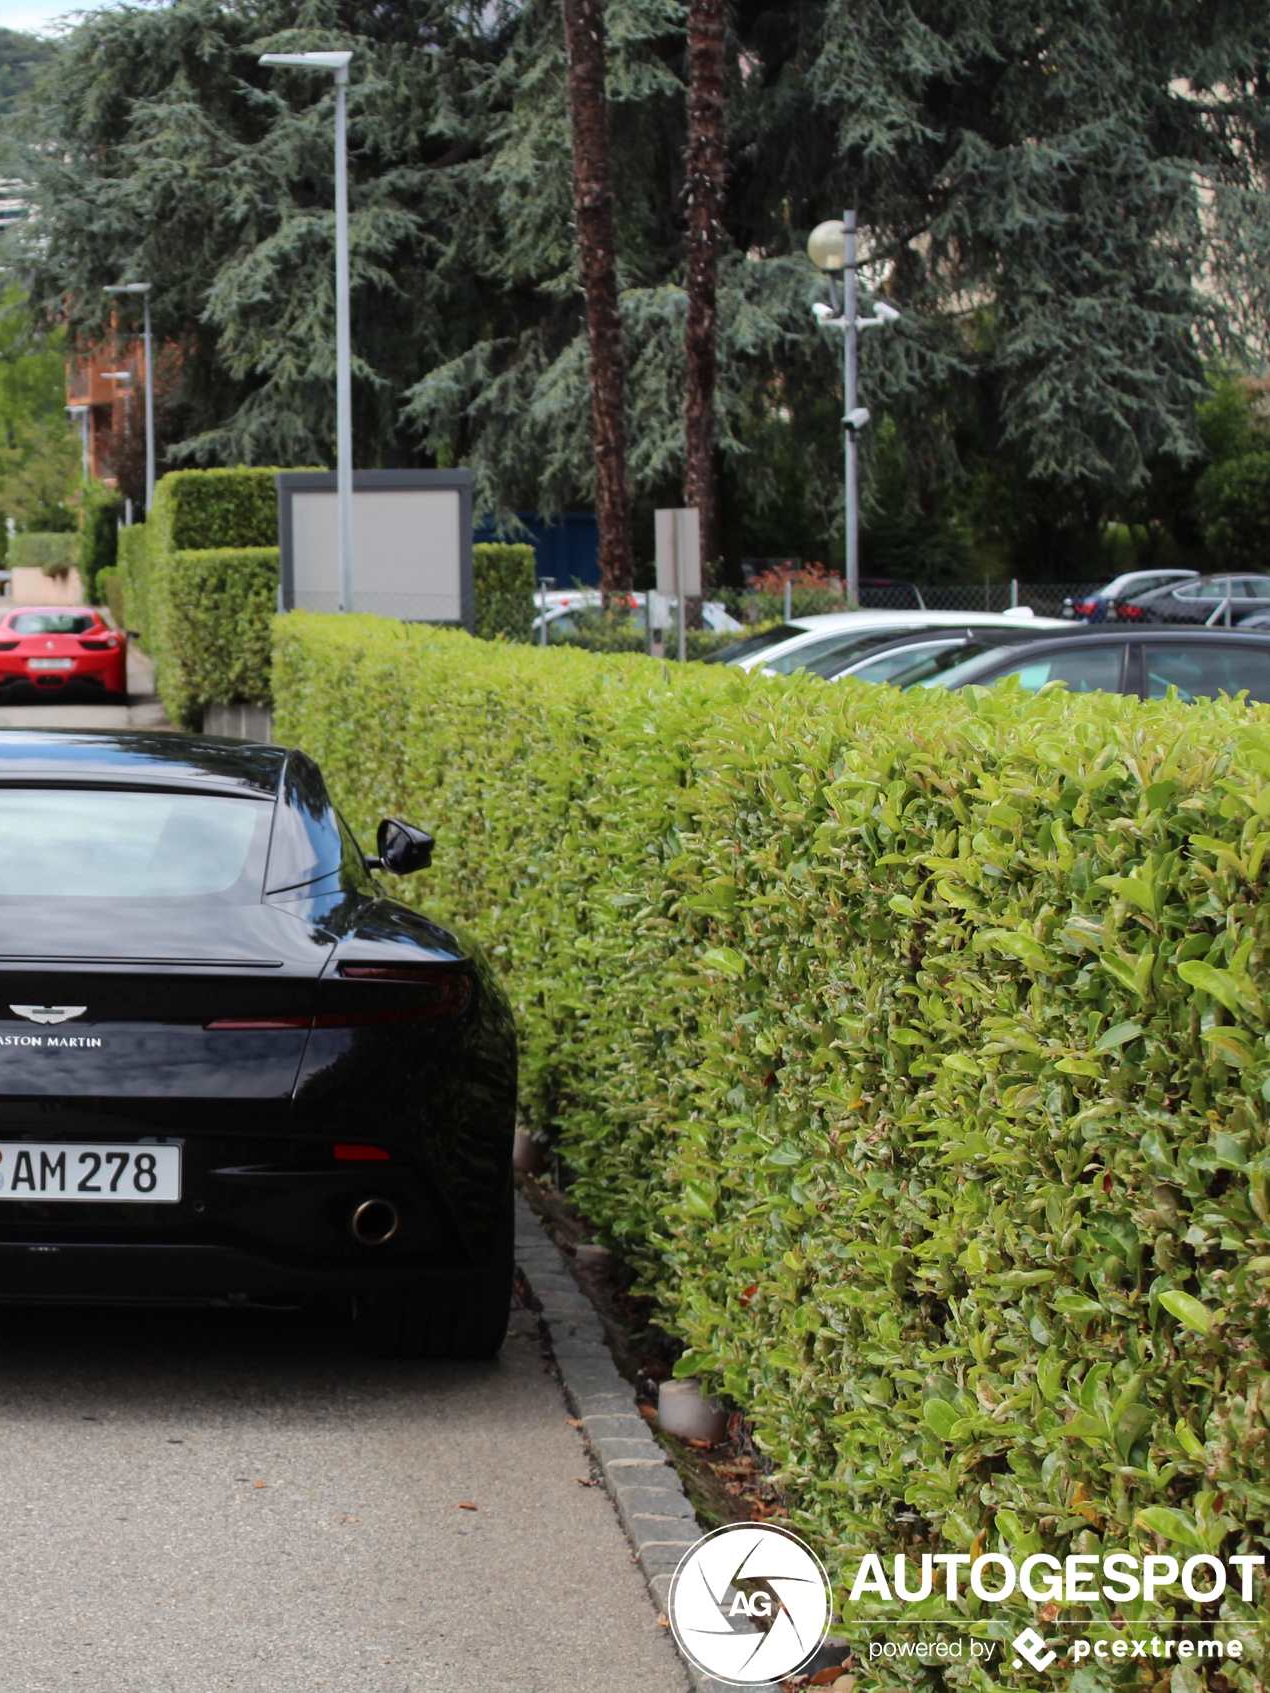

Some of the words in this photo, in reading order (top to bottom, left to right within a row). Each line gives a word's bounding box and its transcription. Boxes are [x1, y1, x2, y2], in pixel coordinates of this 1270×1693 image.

[46, 1036, 102, 1048] MARTIN
[10, 1150, 66, 1192] AM
[77, 1151, 157, 1193] 278
